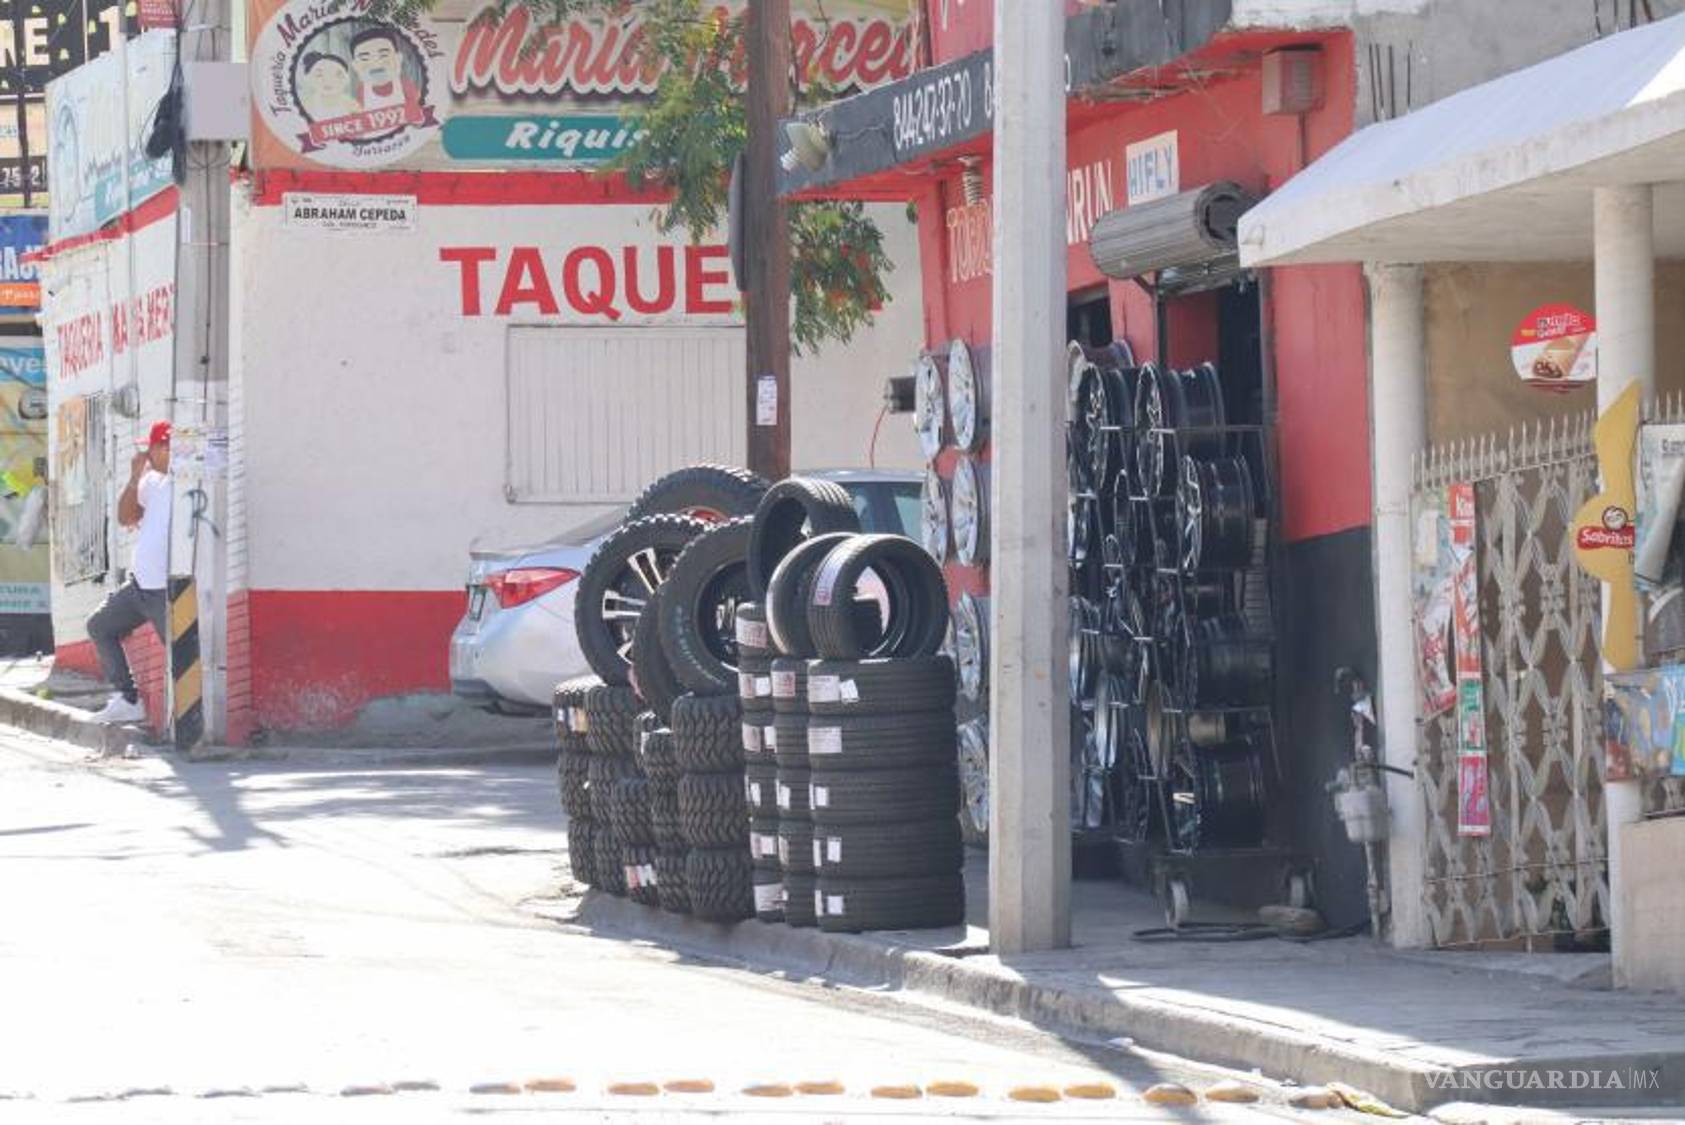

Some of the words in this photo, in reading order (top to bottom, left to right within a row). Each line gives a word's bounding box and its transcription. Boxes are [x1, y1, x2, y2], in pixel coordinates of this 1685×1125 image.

[294, 207, 357, 220] ABRAHAM
[359, 208, 407, 221] CEPEDA
[440, 246, 734, 320] TAQUE
